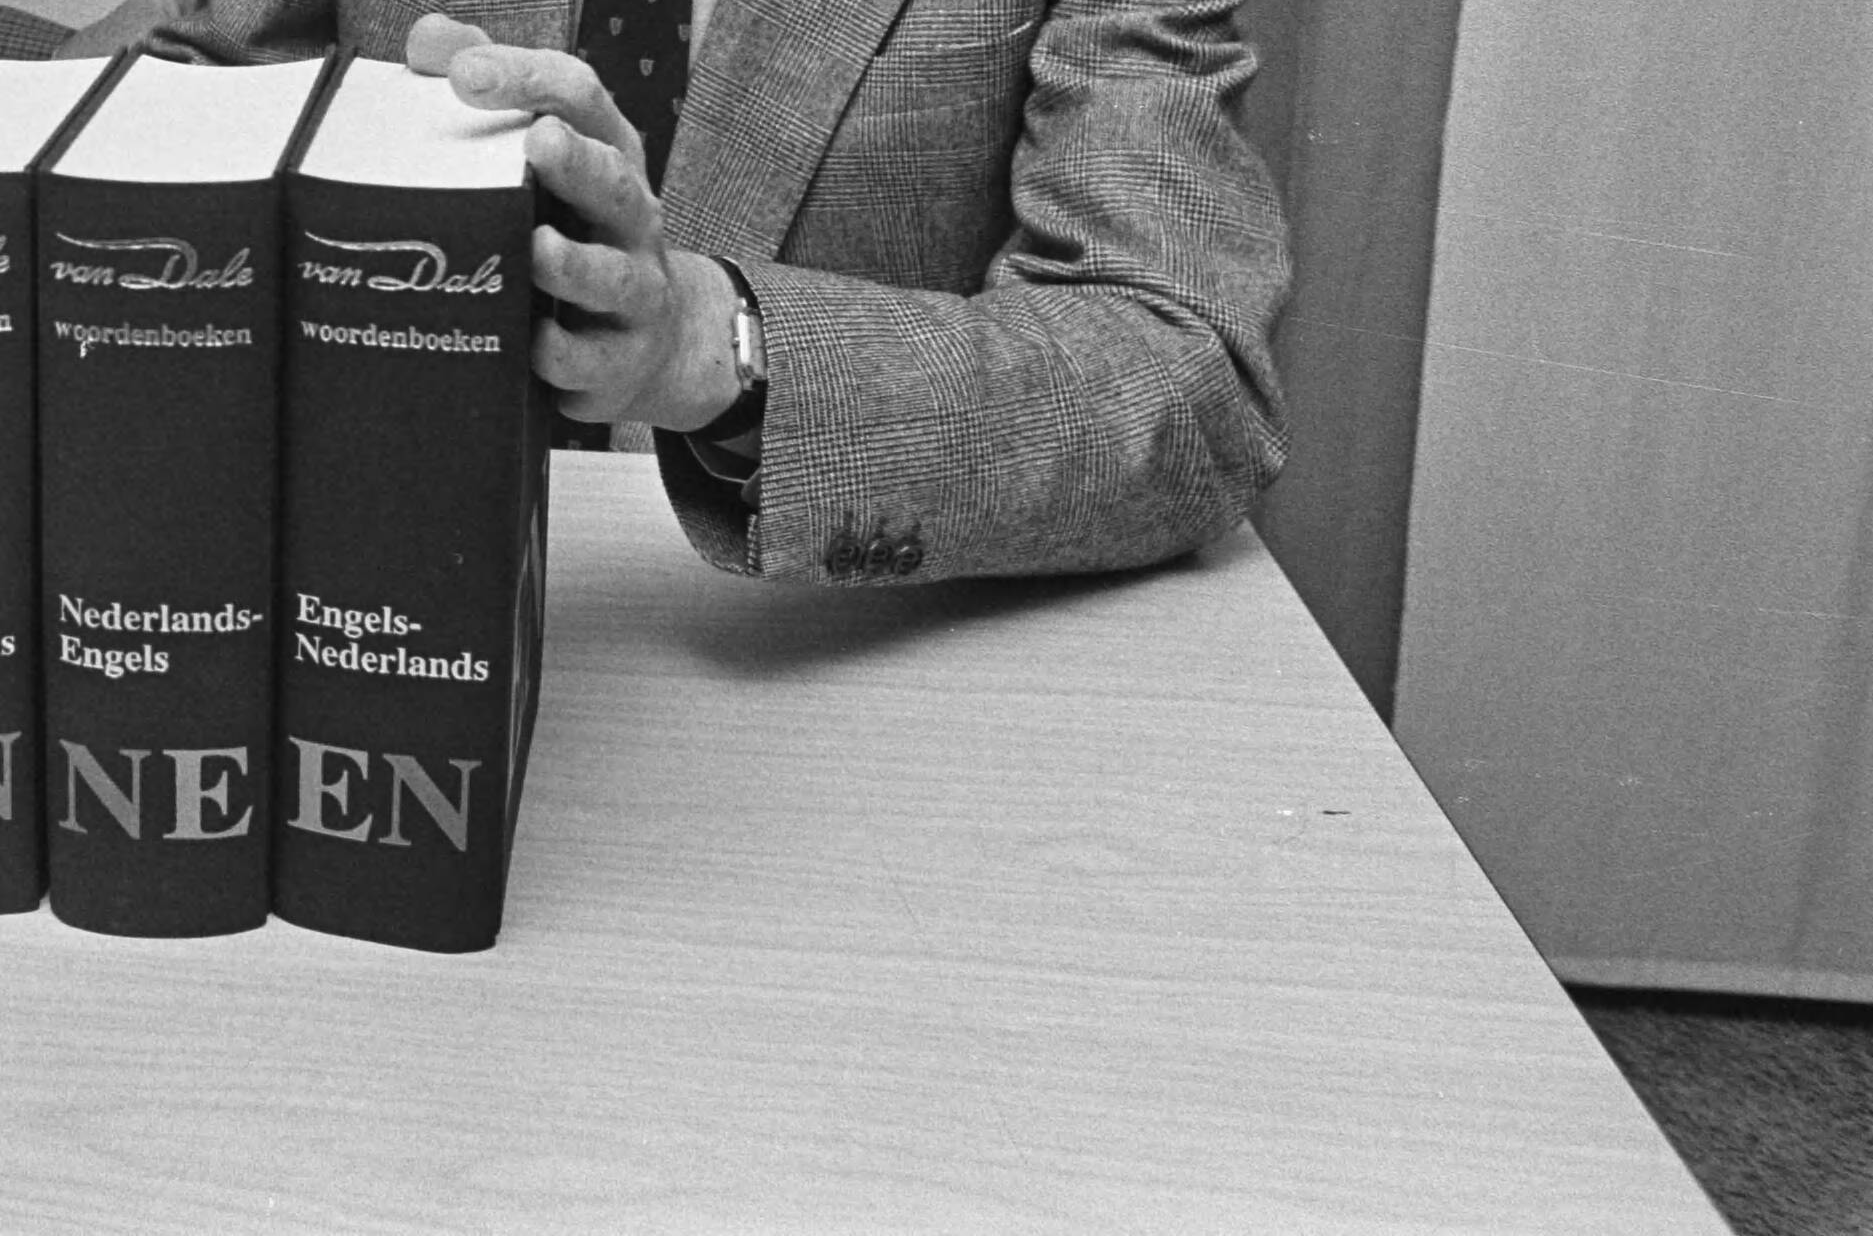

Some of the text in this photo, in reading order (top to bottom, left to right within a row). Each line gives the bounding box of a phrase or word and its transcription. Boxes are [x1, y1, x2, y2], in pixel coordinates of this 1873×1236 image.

[51, 232, 253, 290] van Dale
[299, 230, 503, 293] van Dale
[54, 320, 252, 347] woordenboeken
[301, 320, 501, 352] woordenboeken
[59, 593, 264, 633] Nederlands-
[296, 592, 422, 638] Engels-
[59, 634, 170, 678] Engels
[295, 632, 490, 682] Nederlands
[58, 738, 254, 841] NE
[287, 734, 482, 853] EN
